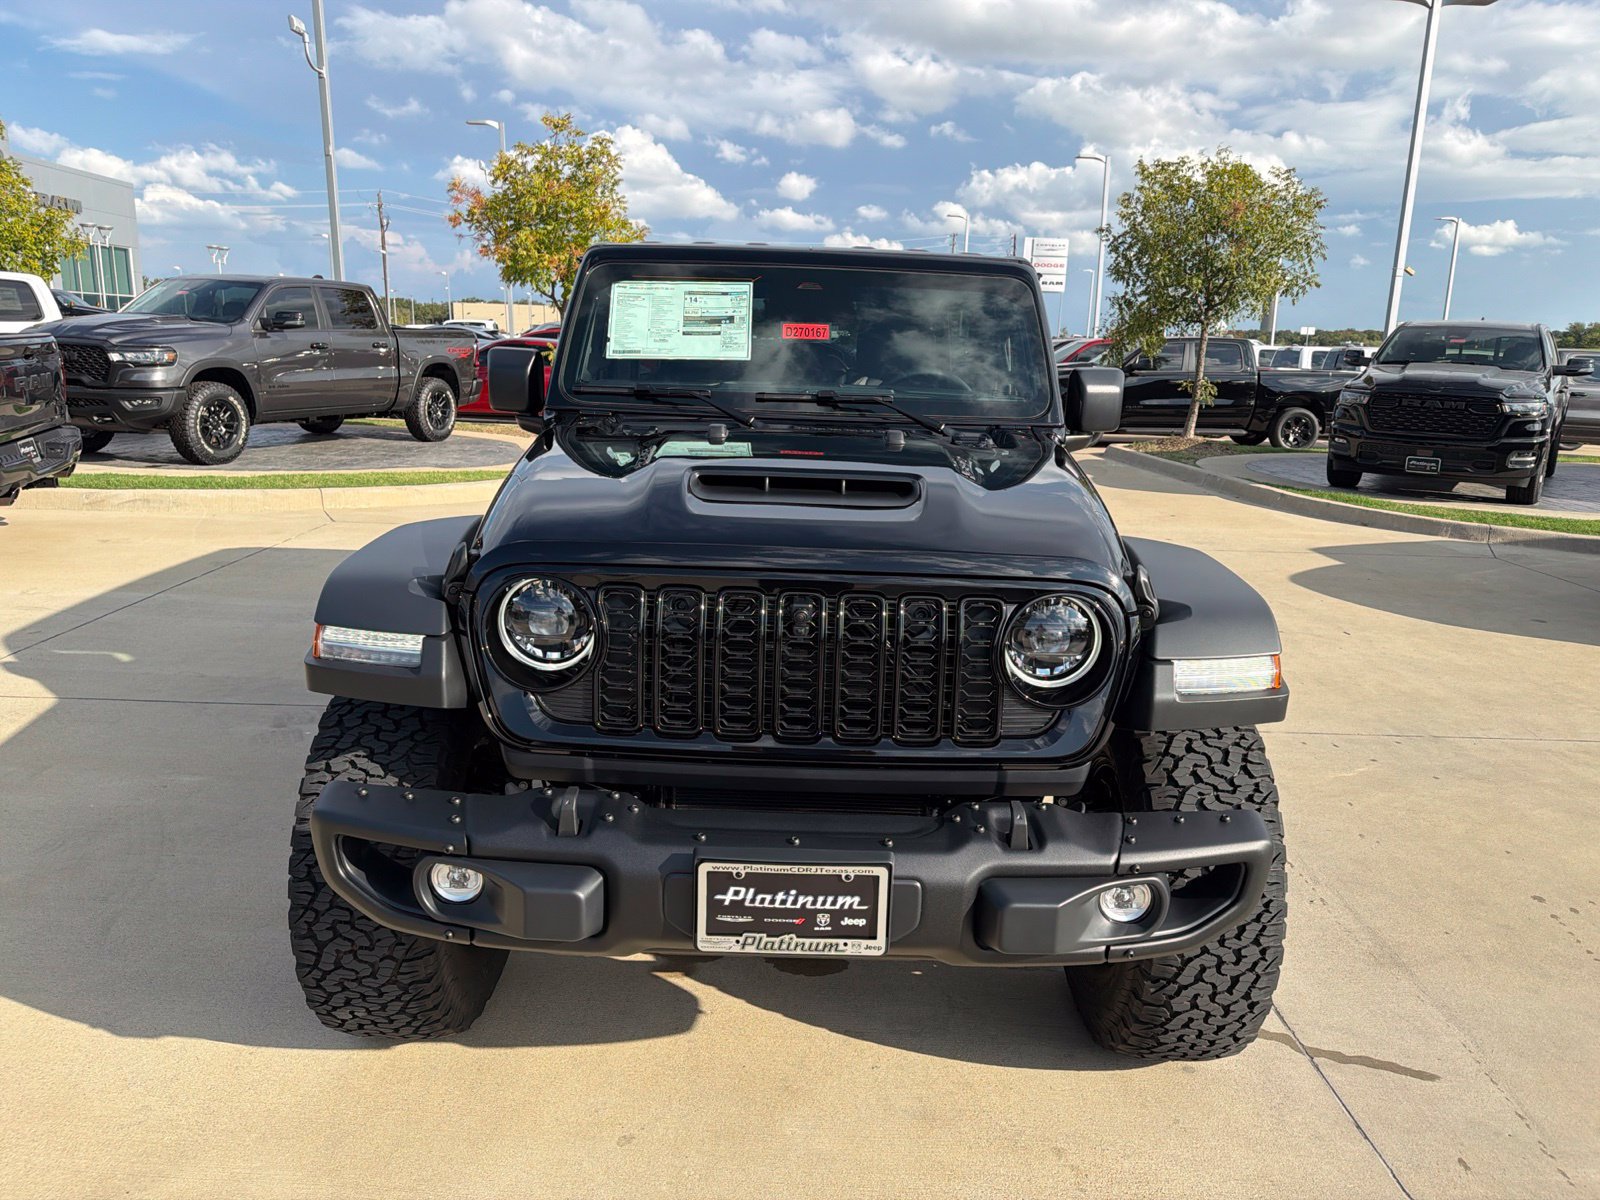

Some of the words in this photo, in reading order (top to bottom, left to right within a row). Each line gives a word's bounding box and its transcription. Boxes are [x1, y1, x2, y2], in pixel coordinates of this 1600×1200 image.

[785, 326, 828, 339] D270167
[14, 372, 53, 393] RAM
[1401, 398, 1466, 409] RAM
[711, 864, 875, 875] www.PlatinumCDRJTexas.com
[714, 886, 870, 910] Platinum
[840, 916, 867, 927] Jeep
[740, 933, 848, 953] Platinum
